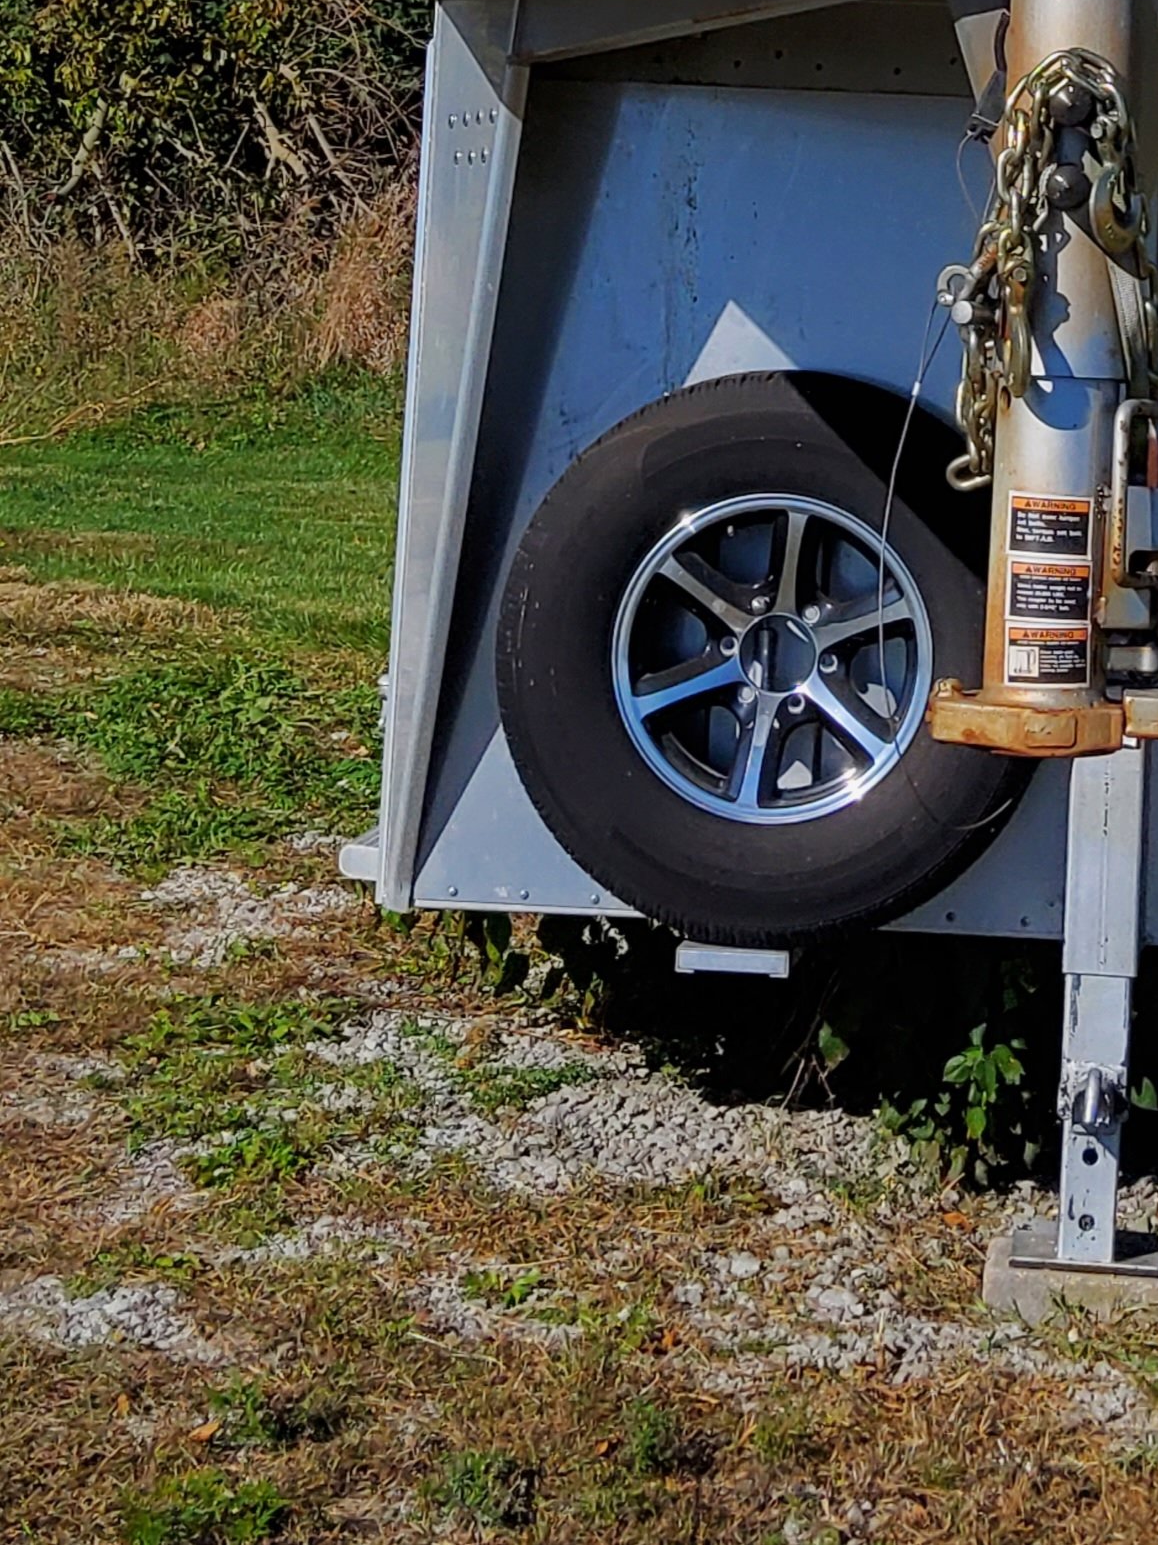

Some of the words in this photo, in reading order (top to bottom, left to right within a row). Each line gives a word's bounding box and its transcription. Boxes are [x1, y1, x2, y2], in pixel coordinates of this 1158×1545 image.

[1031, 502, 1077, 511] WARNING
[1032, 566, 1076, 576] WARNING
[1031, 631, 1074, 639] WARNING
